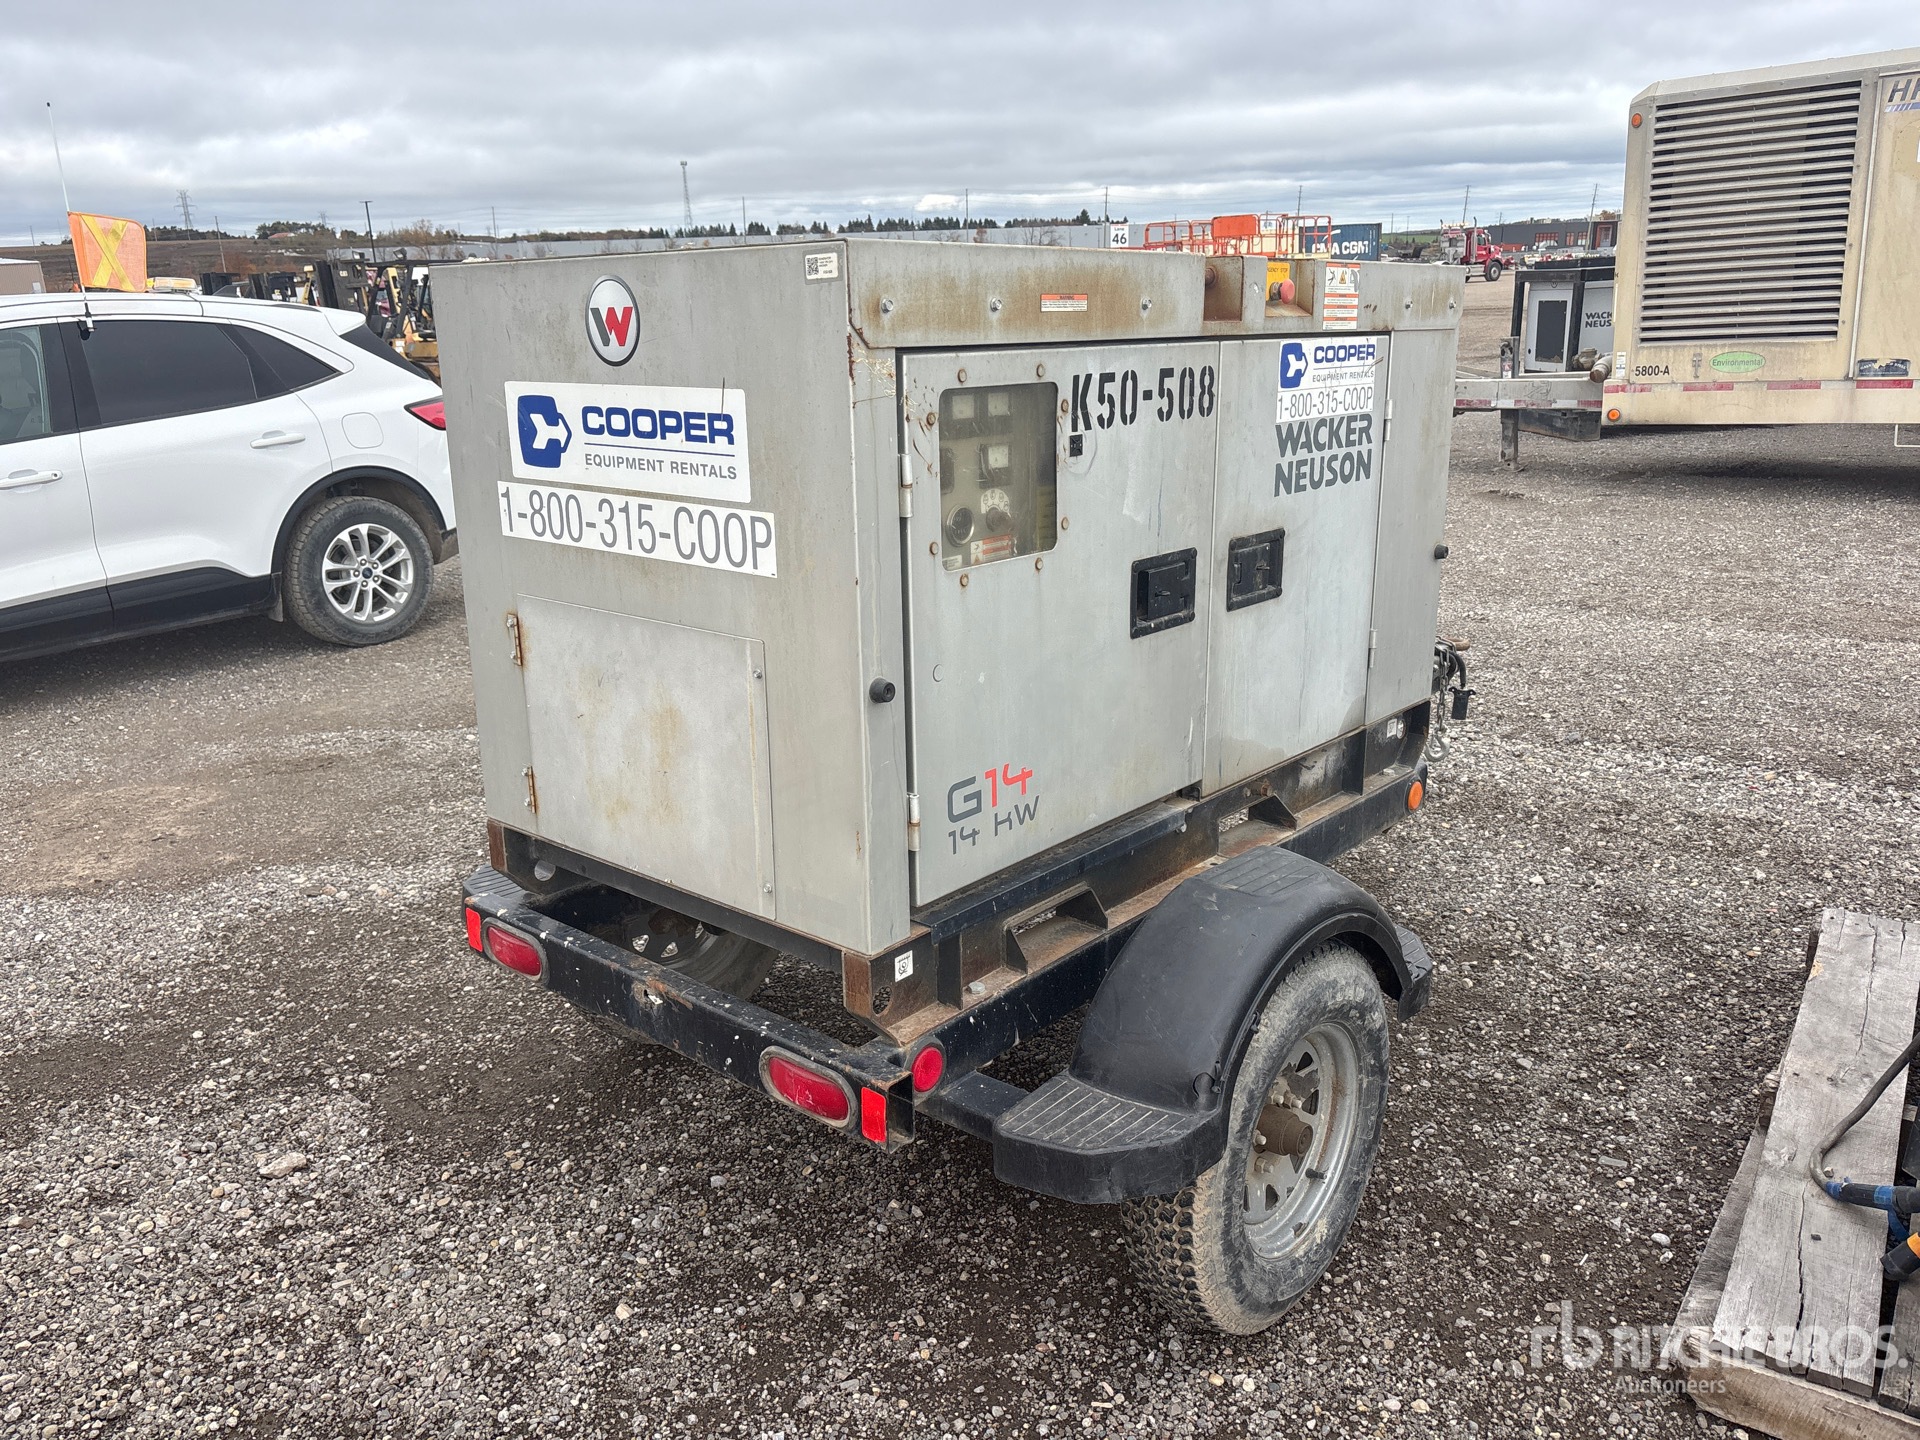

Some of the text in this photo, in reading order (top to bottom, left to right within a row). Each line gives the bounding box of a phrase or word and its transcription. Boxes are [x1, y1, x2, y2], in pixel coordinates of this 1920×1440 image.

[1112, 233, 1127, 244] 46
[1312, 240, 1369, 255] CMA CGM
[590, 307, 633, 346] W
[1313, 344, 1376, 364] COOPER
[1712, 358, 1764, 367] Environmental
[1312, 370, 1375, 383] EQUIPMENT RENTALS
[1634, 365, 1670, 377] 5800-A
[1071, 365, 1215, 433] K50-508
[1278, 387, 1373, 420] 1-800-315-COOP
[582, 405, 735, 446] COOPER
[1275, 413, 1373, 459] WACKER
[584, 453, 738, 480] EQUIPMENT RENTALS
[1274, 448, 1373, 498] NEUSON
[500, 486, 773, 570] 1-800-315-COOP
[947, 763, 1033, 823] G14
[948, 826, 981, 855] 14
